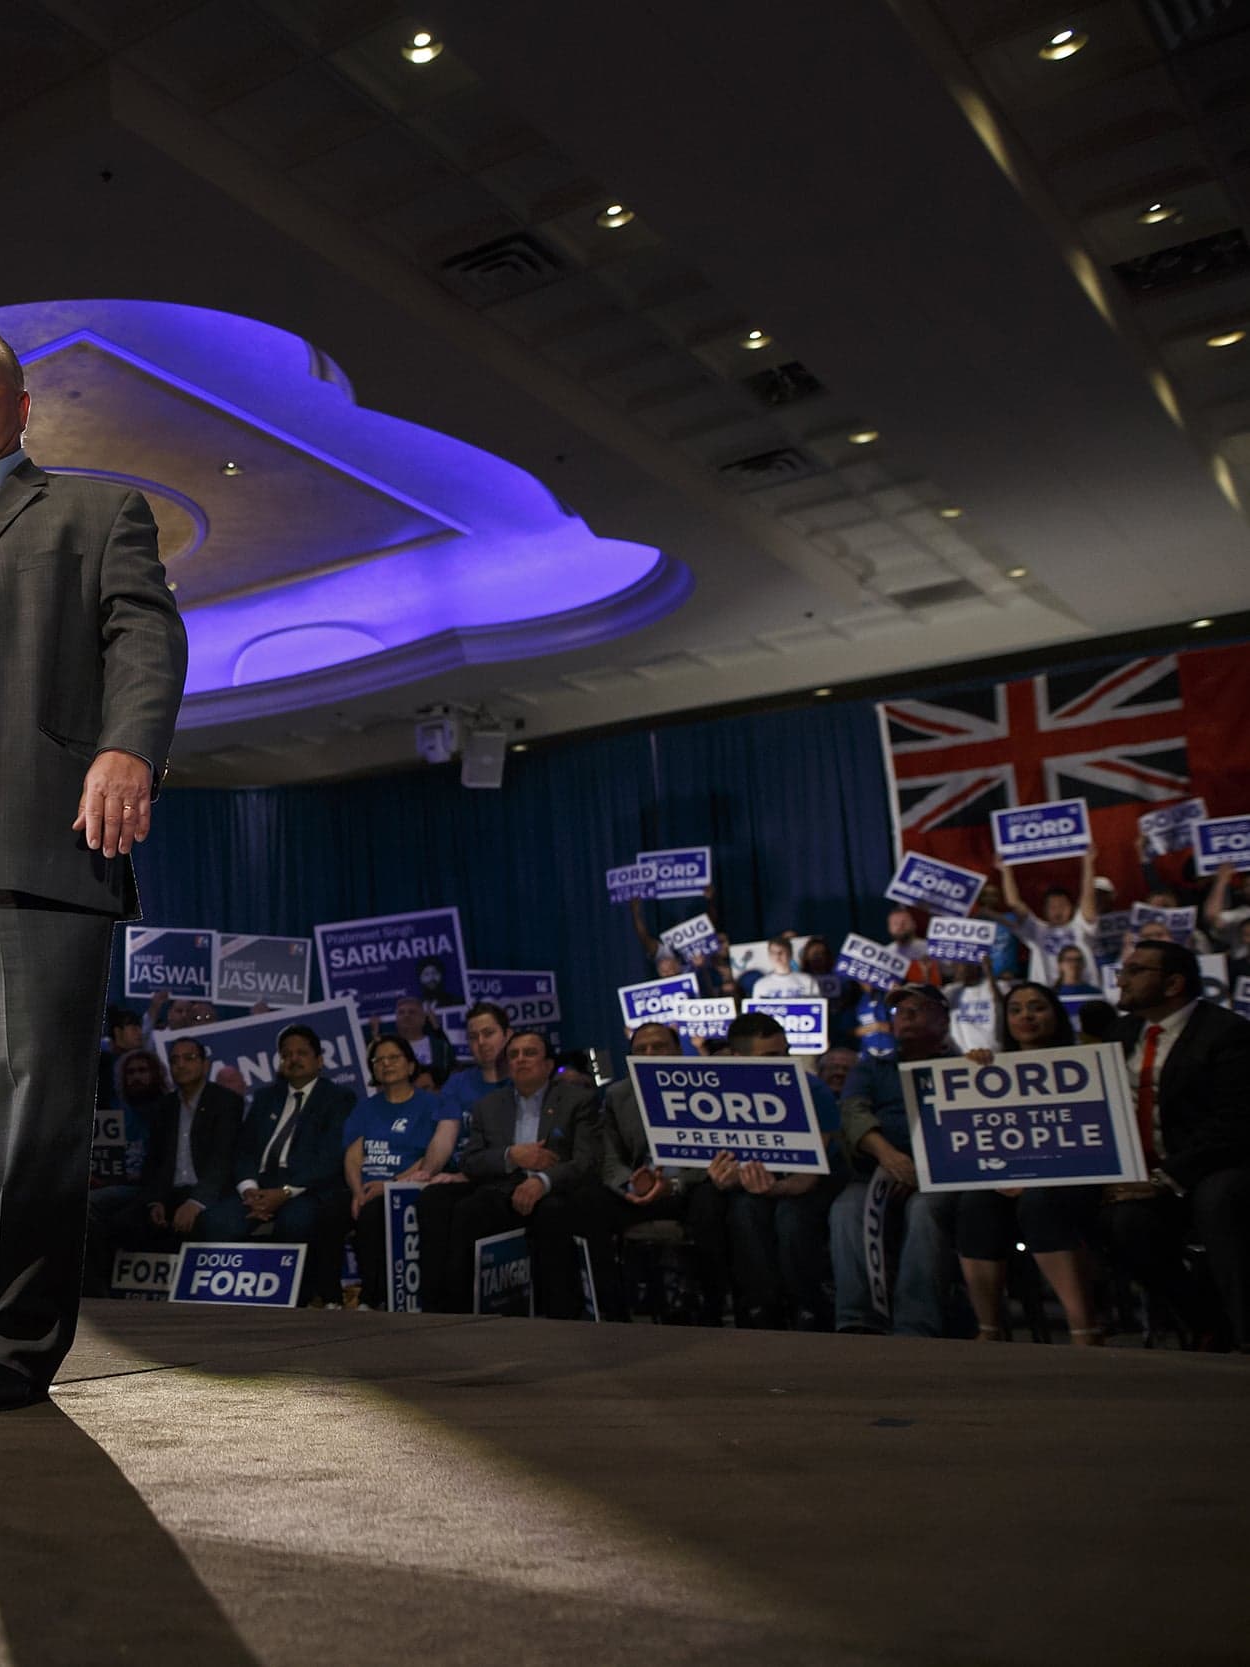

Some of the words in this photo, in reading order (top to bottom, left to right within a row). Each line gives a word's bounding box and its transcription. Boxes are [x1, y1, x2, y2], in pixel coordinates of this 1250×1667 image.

[1008, 817, 1076, 842] FORD
[1210, 832, 1250, 852] FO
[657, 862, 700, 880] ORD
[907, 870, 967, 900] FORD
[933, 921, 991, 941] DOUG
[330, 933, 454, 969] SARKARIA
[848, 938, 905, 972] FORD
[130, 964, 211, 986] JASWAL
[219, 970, 303, 994] JASWAL
[469, 978, 503, 994] OUG
[504, 1000, 554, 1021] ORD
[677, 1003, 730, 1017] FORD
[679, 1025, 728, 1037] PEOPL
[655, 1071, 721, 1087] DOUG
[942, 1060, 1090, 1101] FORD
[660, 1090, 788, 1125] FORD
[972, 1112, 1019, 1127] FOR
[1027, 1109, 1073, 1124] THE
[676, 1131, 786, 1147] PREMIER
[950, 1124, 1103, 1153] PEOPLE
[362, 1154, 403, 1166] ANGRI
[671, 1147, 700, 1157] FOR
[742, 1150, 800, 1162] PEOPLE
[196, 1253, 243, 1267] DOUG
[403, 1203, 423, 1312] FORD
[117, 1259, 178, 1284] FOR
[189, 1269, 281, 1298] FORD
